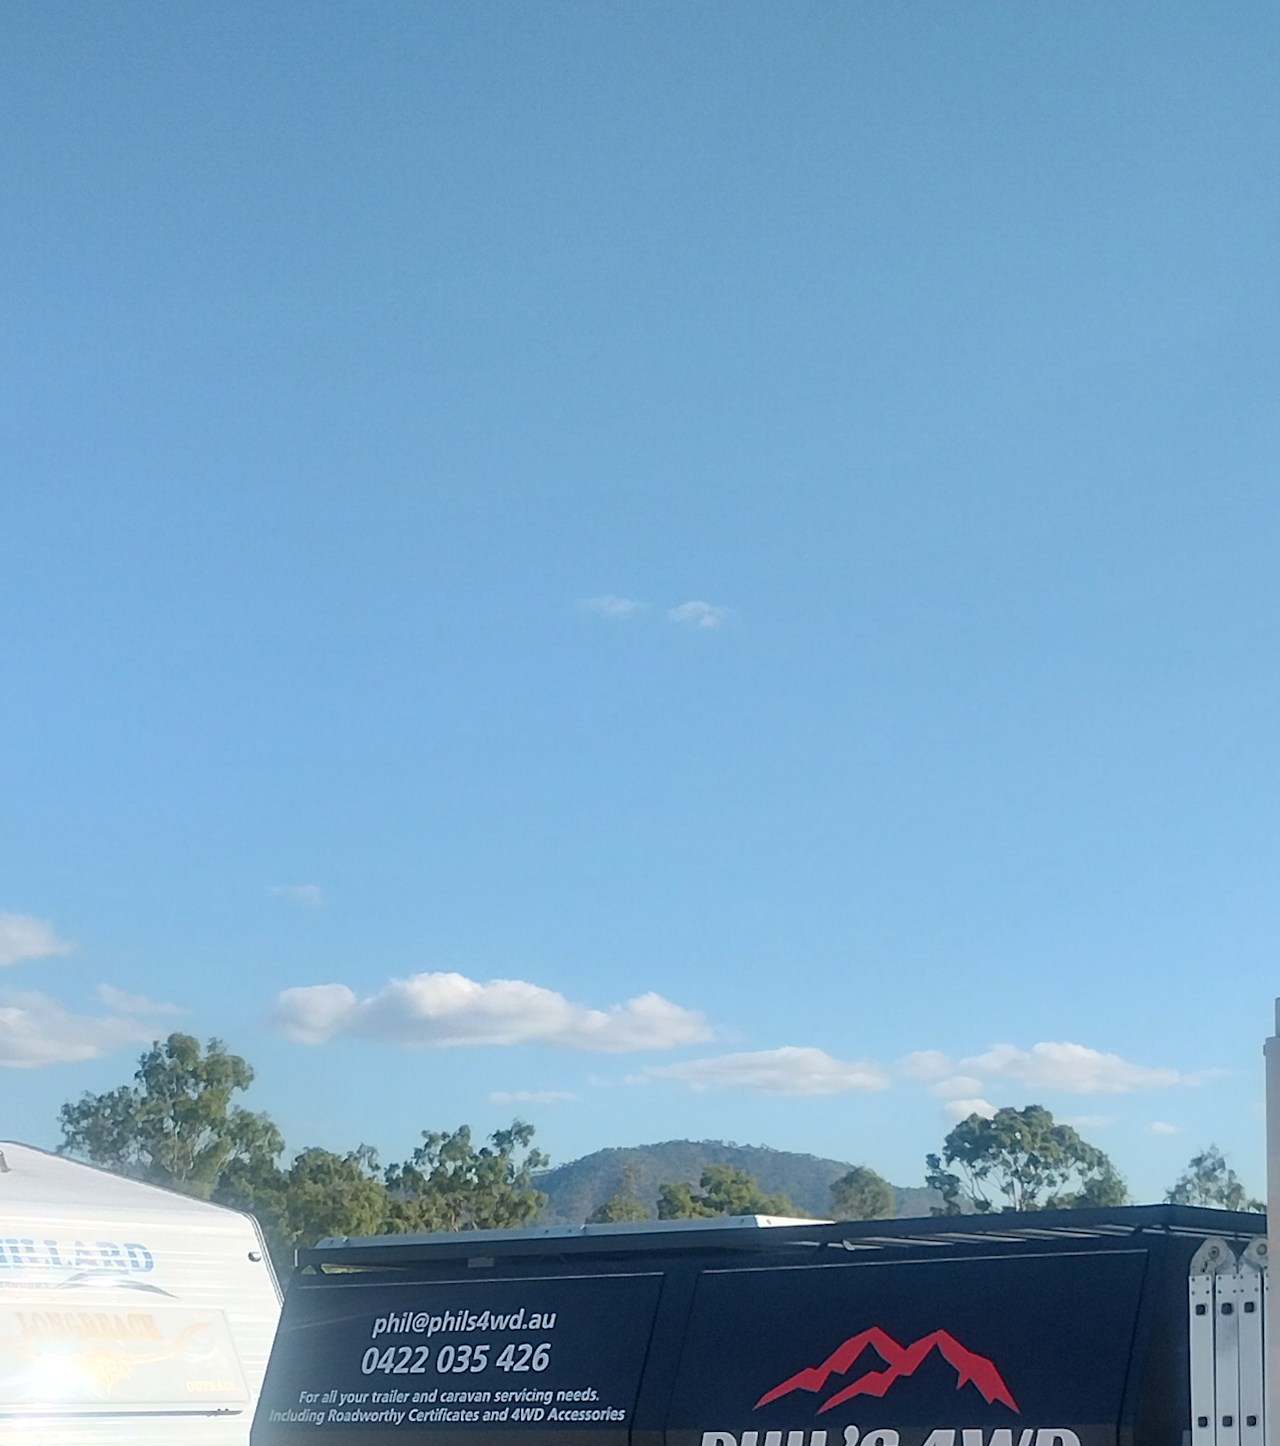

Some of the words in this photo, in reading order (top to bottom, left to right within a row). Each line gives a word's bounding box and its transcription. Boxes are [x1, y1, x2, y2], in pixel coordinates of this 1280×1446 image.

[372, 1309, 557, 1338] phil@phils4wd.au
[361, 1346, 426, 1375] 0422
[436, 1345, 488, 1373] 035
[496, 1343, 552, 1372] 426
[299, 1391, 320, 1404] For
[321, 1390, 338, 1404] all
[339, 1393, 369, 1407] your
[371, 1389, 411, 1404] trailer
[412, 1389, 437, 1403] and
[440, 1392, 492, 1403] caravan
[494, 1389, 553, 1406] servicing
[556, 1388, 600, 1403] needs.
[270, 1408, 324, 1426] Including
[327, 1408, 406, 1426] Roadworthy
[408, 1407, 480, 1423] Certificates
[482, 1408, 508, 1422] and
[511, 1408, 545, 1422] 4WD
[547, 1407, 626, 1422] Accessories
